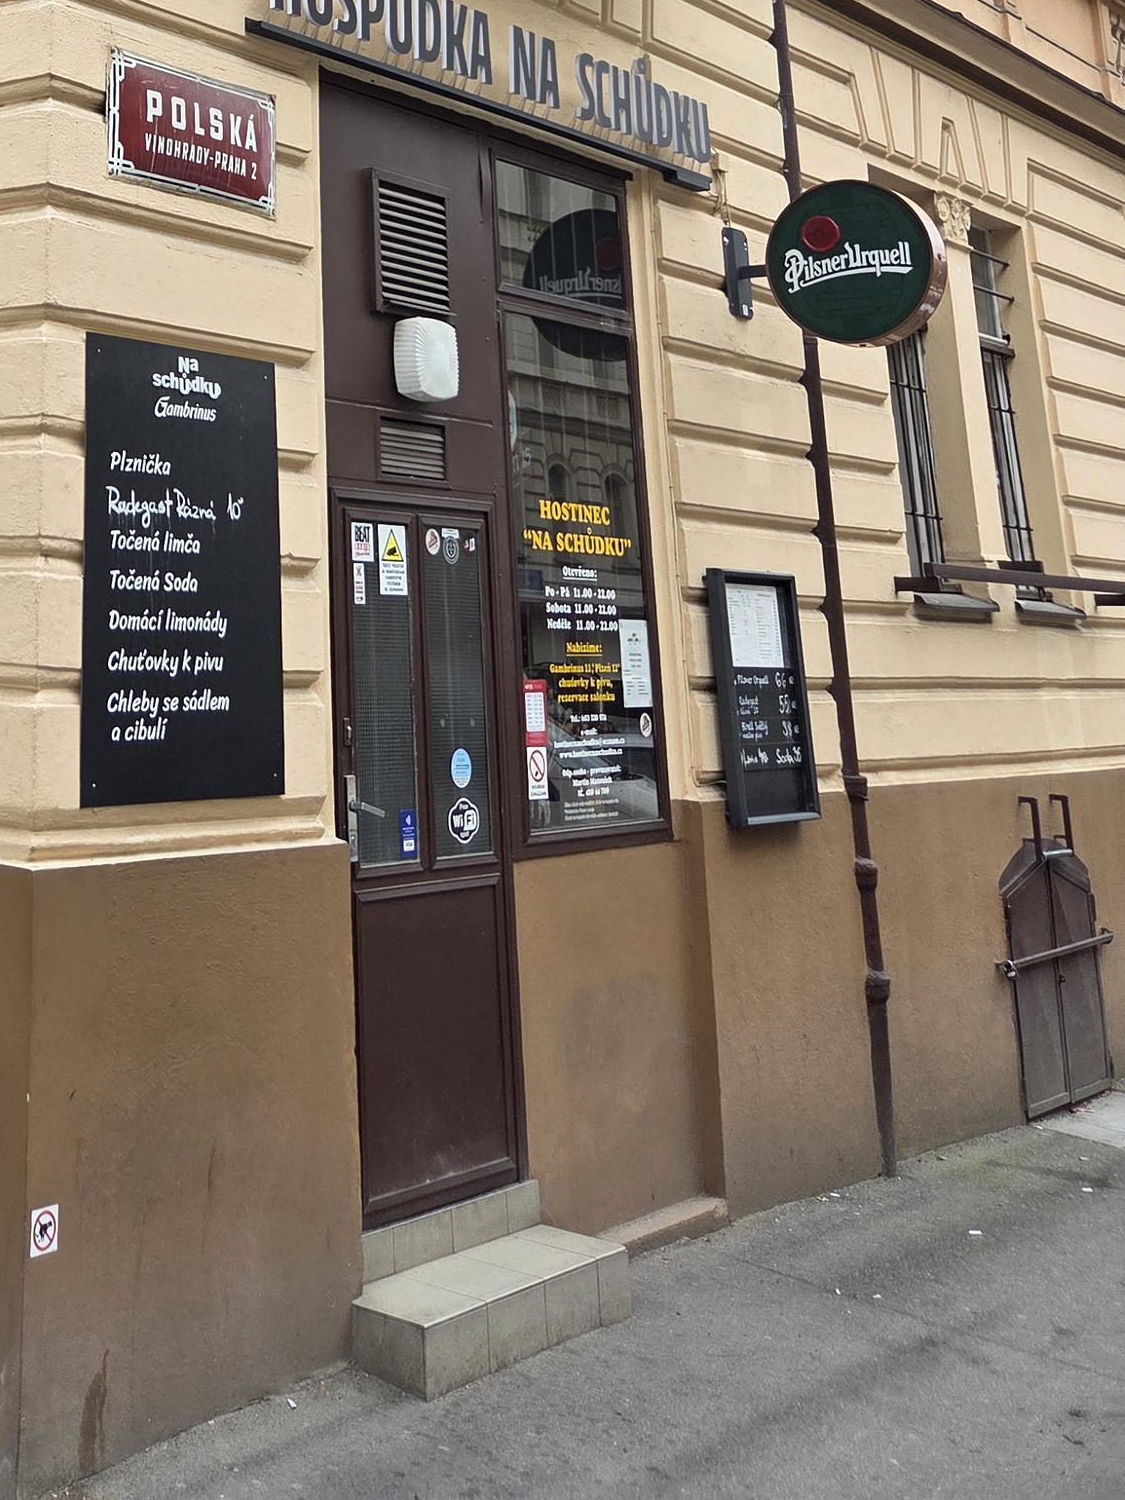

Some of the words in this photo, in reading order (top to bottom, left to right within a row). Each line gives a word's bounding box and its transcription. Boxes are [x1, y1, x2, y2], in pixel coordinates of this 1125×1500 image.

[509, 24, 560, 109] NA
[575, 51, 712, 164] SCHŮDKU
[146, 89, 258, 153] POLSKÁ
[251, 162, 257, 180] 2
[784, 247, 847, 294] Pilsner
[844, 241, 912, 278] Urquell
[178, 356, 199, 373] Na
[154, 396, 217, 422] Gambrinus
[110, 450, 171, 475] Plznička
[105, 486, 173, 528] Radegast
[539, 499, 610, 525] HOSTINEC
[110, 529, 160, 552] Točená
[164, 531, 201, 554] limča
[109, 569, 160, 592] Točená
[163, 571, 198, 592] Soda
[544, 586, 554, 597] Po
[546, 602, 571, 614] Sobota
[108, 609, 164, 631] Domácí
[165, 608, 227, 638] limonády
[547, 618, 572, 630] Neděle
[107, 648, 179, 677] Chuťovky
[182, 648, 190, 671] k
[194, 651, 223, 675] pivu
[107, 689, 159, 718] Chleby
[162, 696, 179, 712] se
[182, 689, 230, 712] sádlem
[111, 726, 120, 741] a
[125, 717, 168, 741] cibulí
